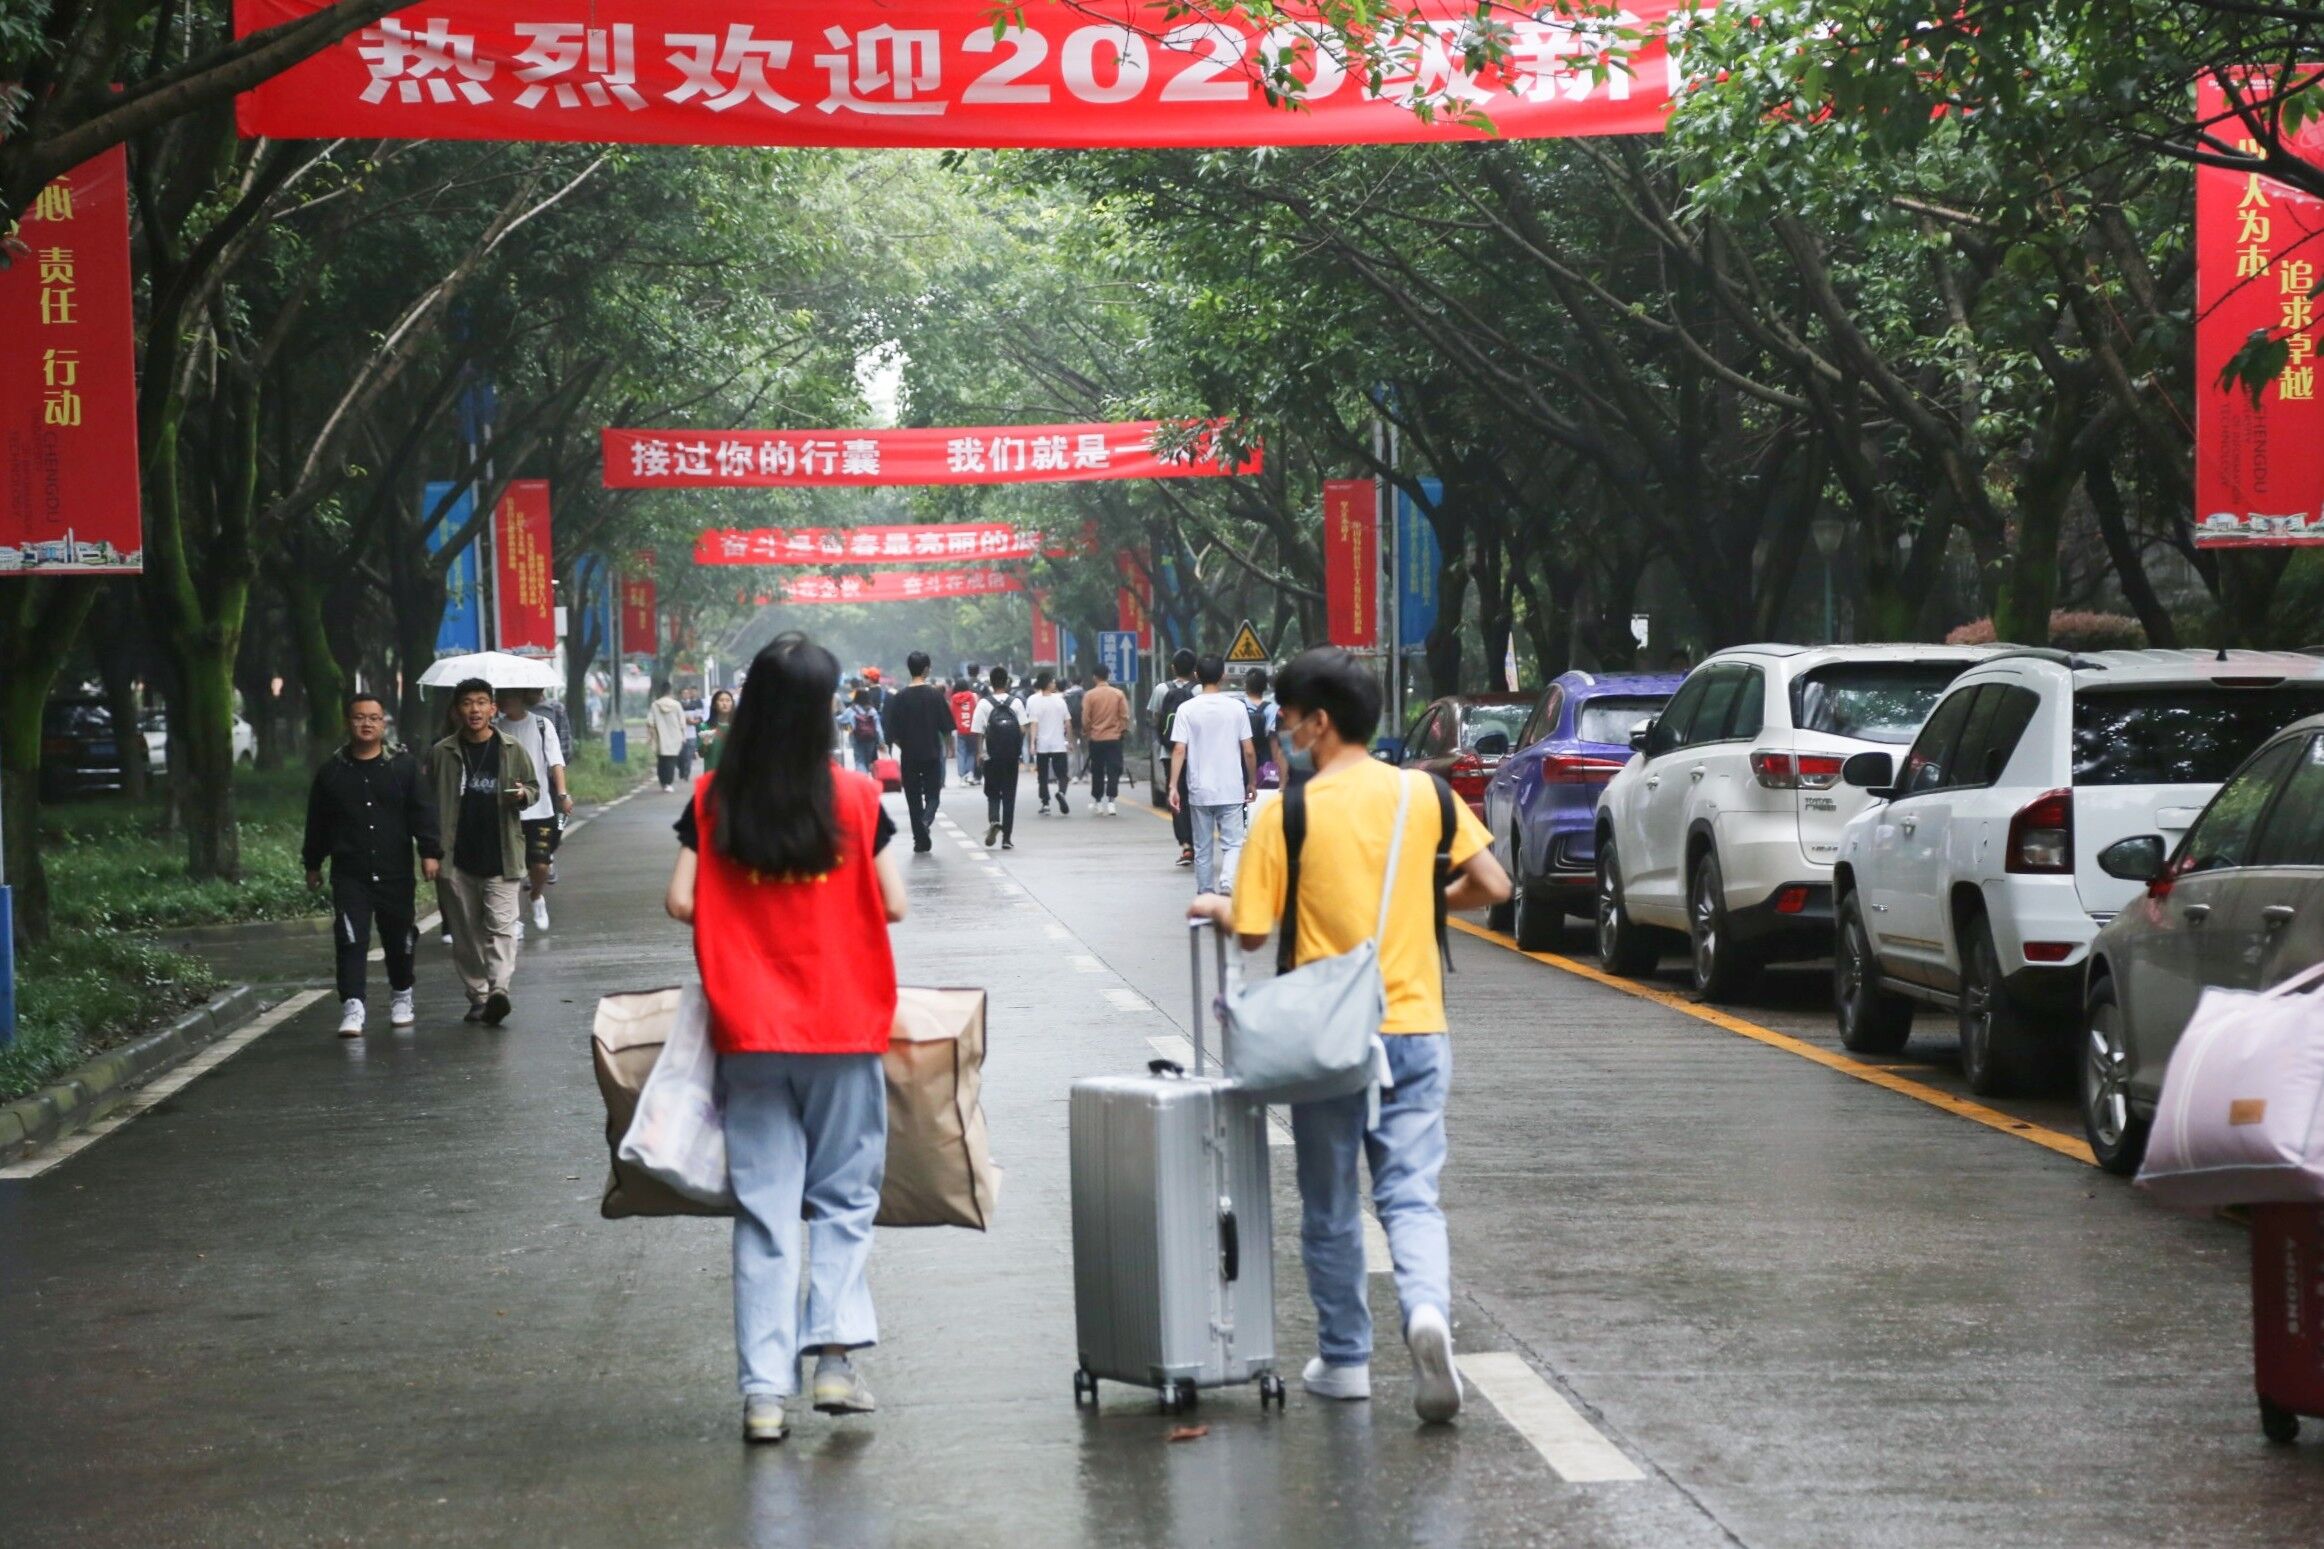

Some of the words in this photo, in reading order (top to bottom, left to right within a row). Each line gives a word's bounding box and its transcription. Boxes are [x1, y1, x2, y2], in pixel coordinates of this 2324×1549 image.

[38, 247, 78, 324] 责任
[2279, 260, 2314, 400] 追求卓越
[43, 349, 81, 426] 行动
[631, 438, 881, 477] 接过你的行囊
